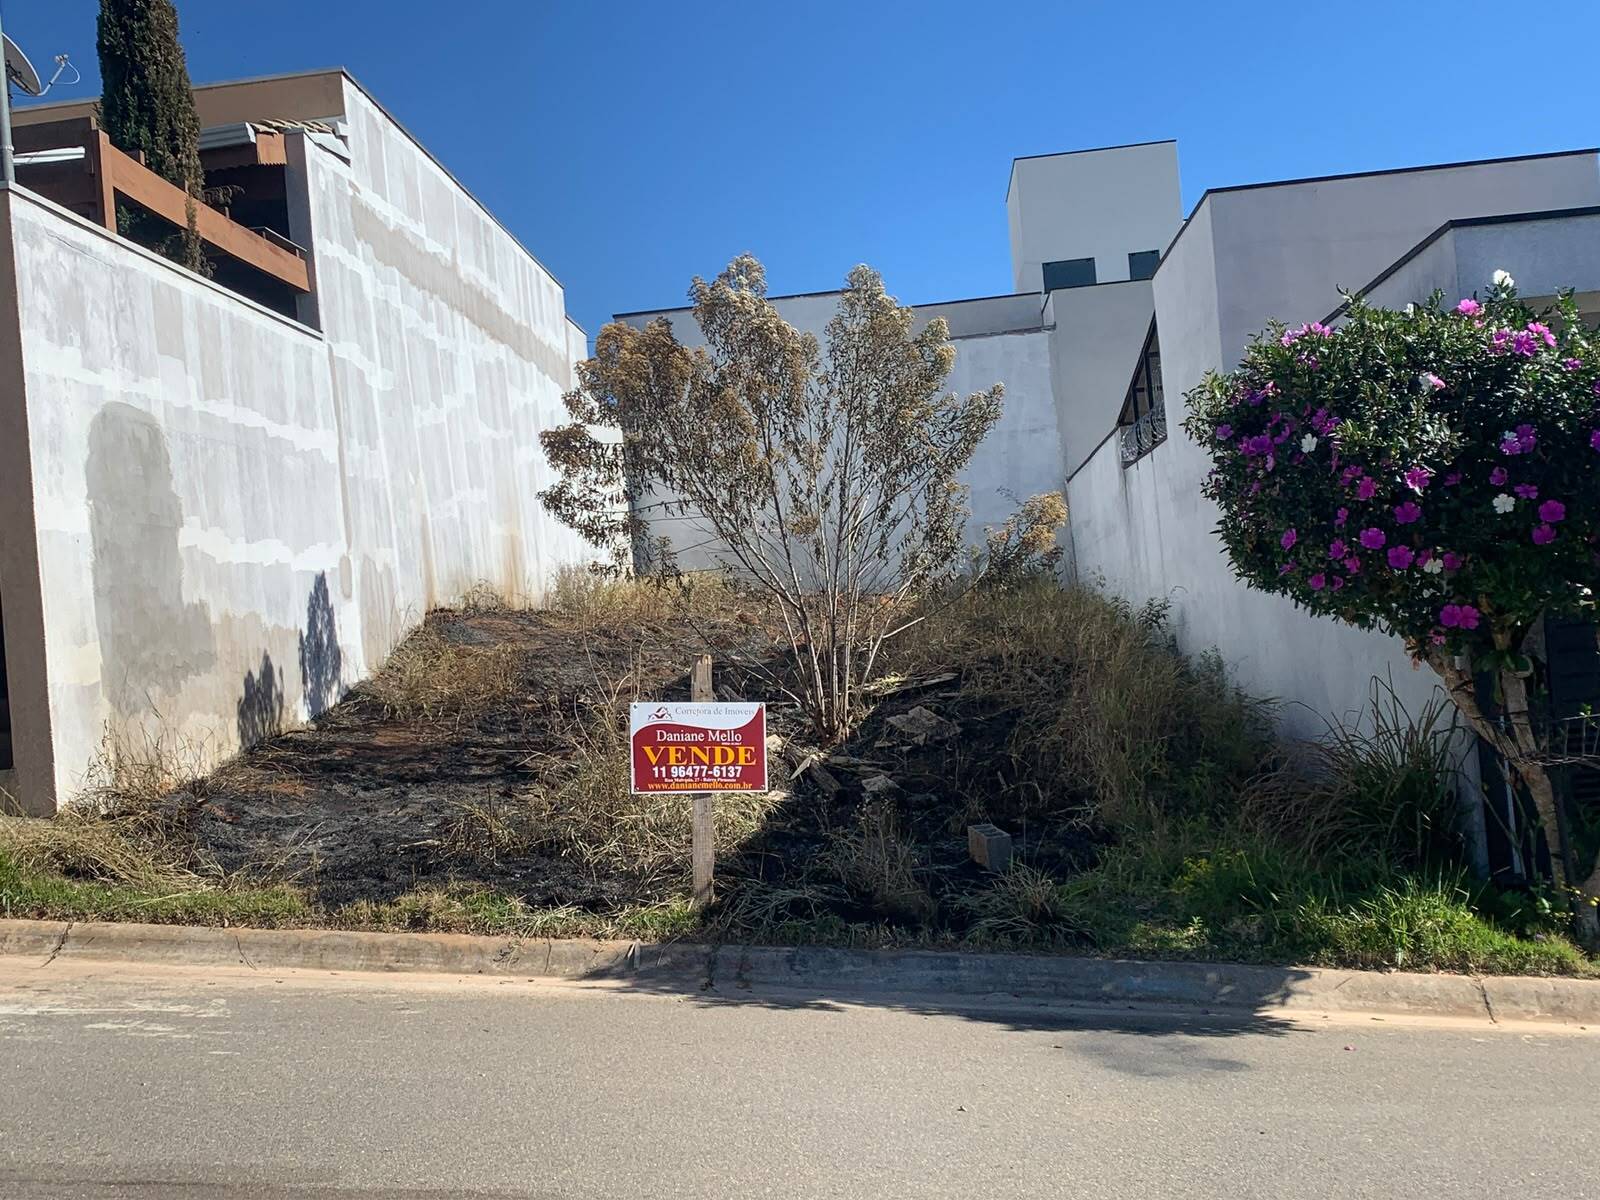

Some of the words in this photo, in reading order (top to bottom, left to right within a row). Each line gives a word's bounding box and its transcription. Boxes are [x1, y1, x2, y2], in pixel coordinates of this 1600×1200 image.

[713, 706, 723, 715] de
[656, 730, 705, 742] Daniane
[708, 730, 742, 742] Mello
[642, 746, 757, 766] VENDE
[652, 766, 667, 778] 11
[671, 766, 743, 778] 96477-6137
[648, 782, 753, 790] www.danianemello.com.br
